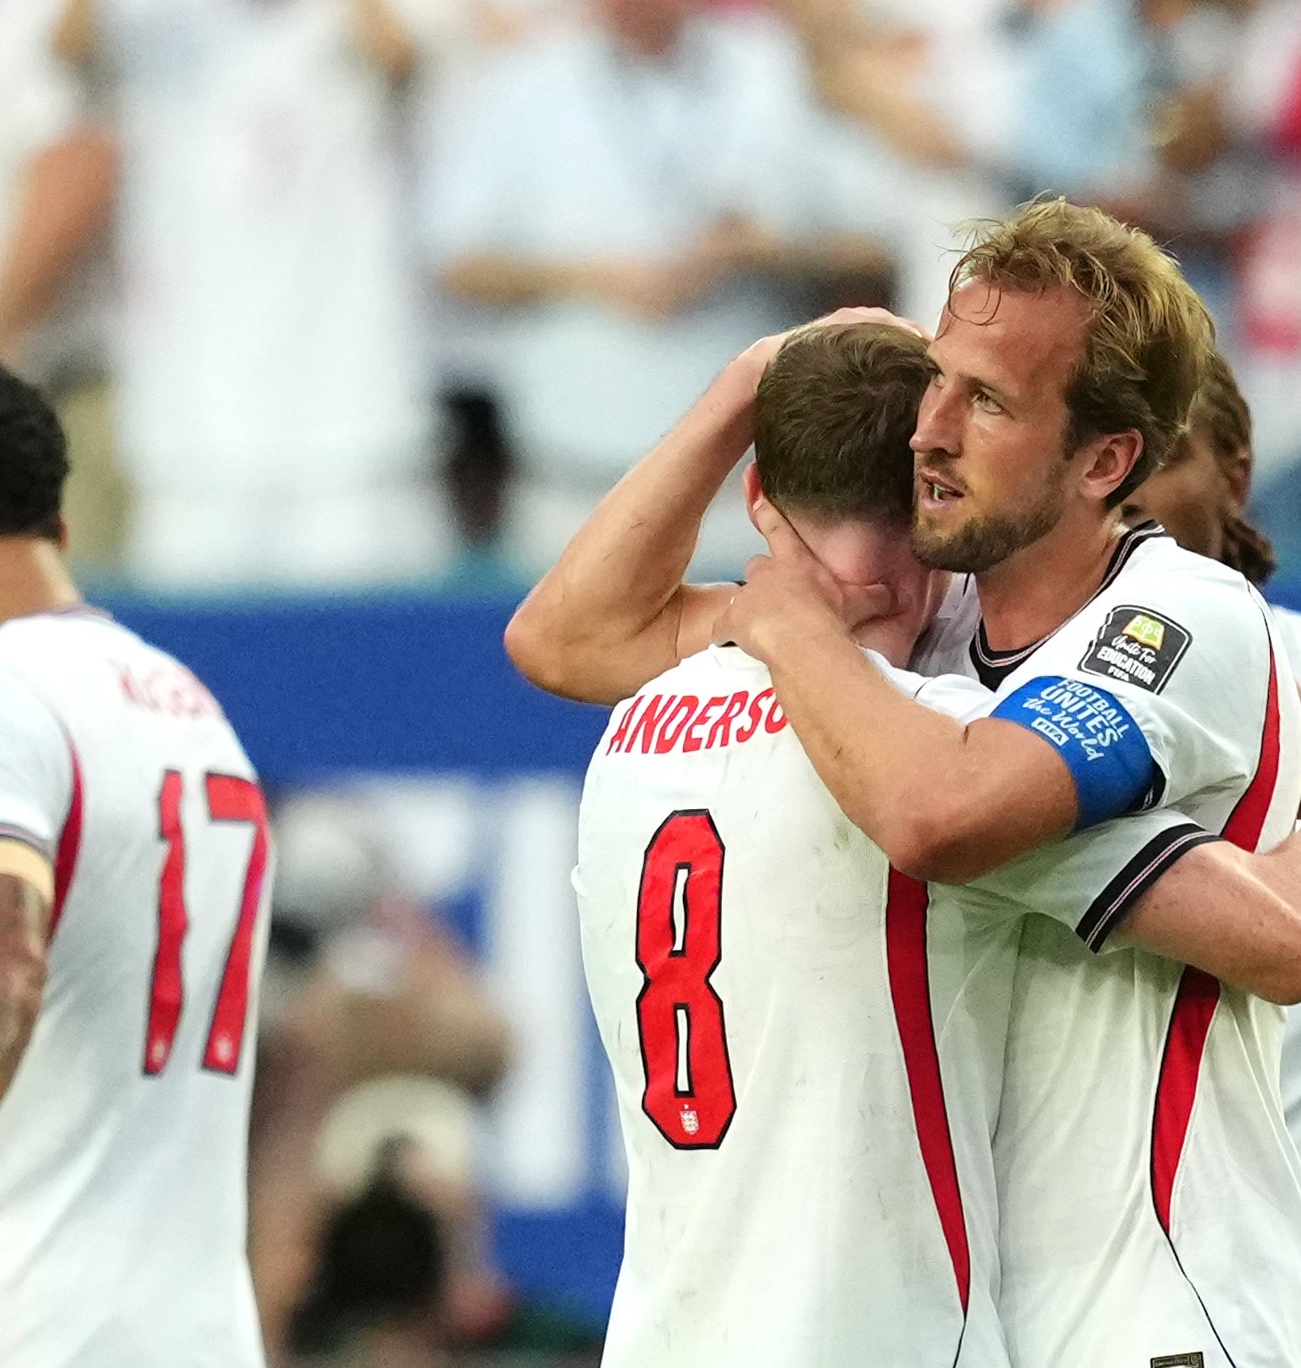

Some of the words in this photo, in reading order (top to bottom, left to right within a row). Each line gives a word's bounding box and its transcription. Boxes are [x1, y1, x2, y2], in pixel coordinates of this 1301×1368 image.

[1096, 646, 1156, 685] EDUCATION
[1107, 665, 1130, 681] FIFA
[1111, 634, 1141, 655] Unite
[1022, 697, 1052, 716] the
[1051, 710, 1104, 761] World
[1035, 719, 1064, 743] FIFA
[1040, 686, 1118, 747] UNITES
[1058, 678, 1129, 738] FOOTBALL
[141, 768, 270, 1077] 17
[635, 808, 737, 1150] 8
